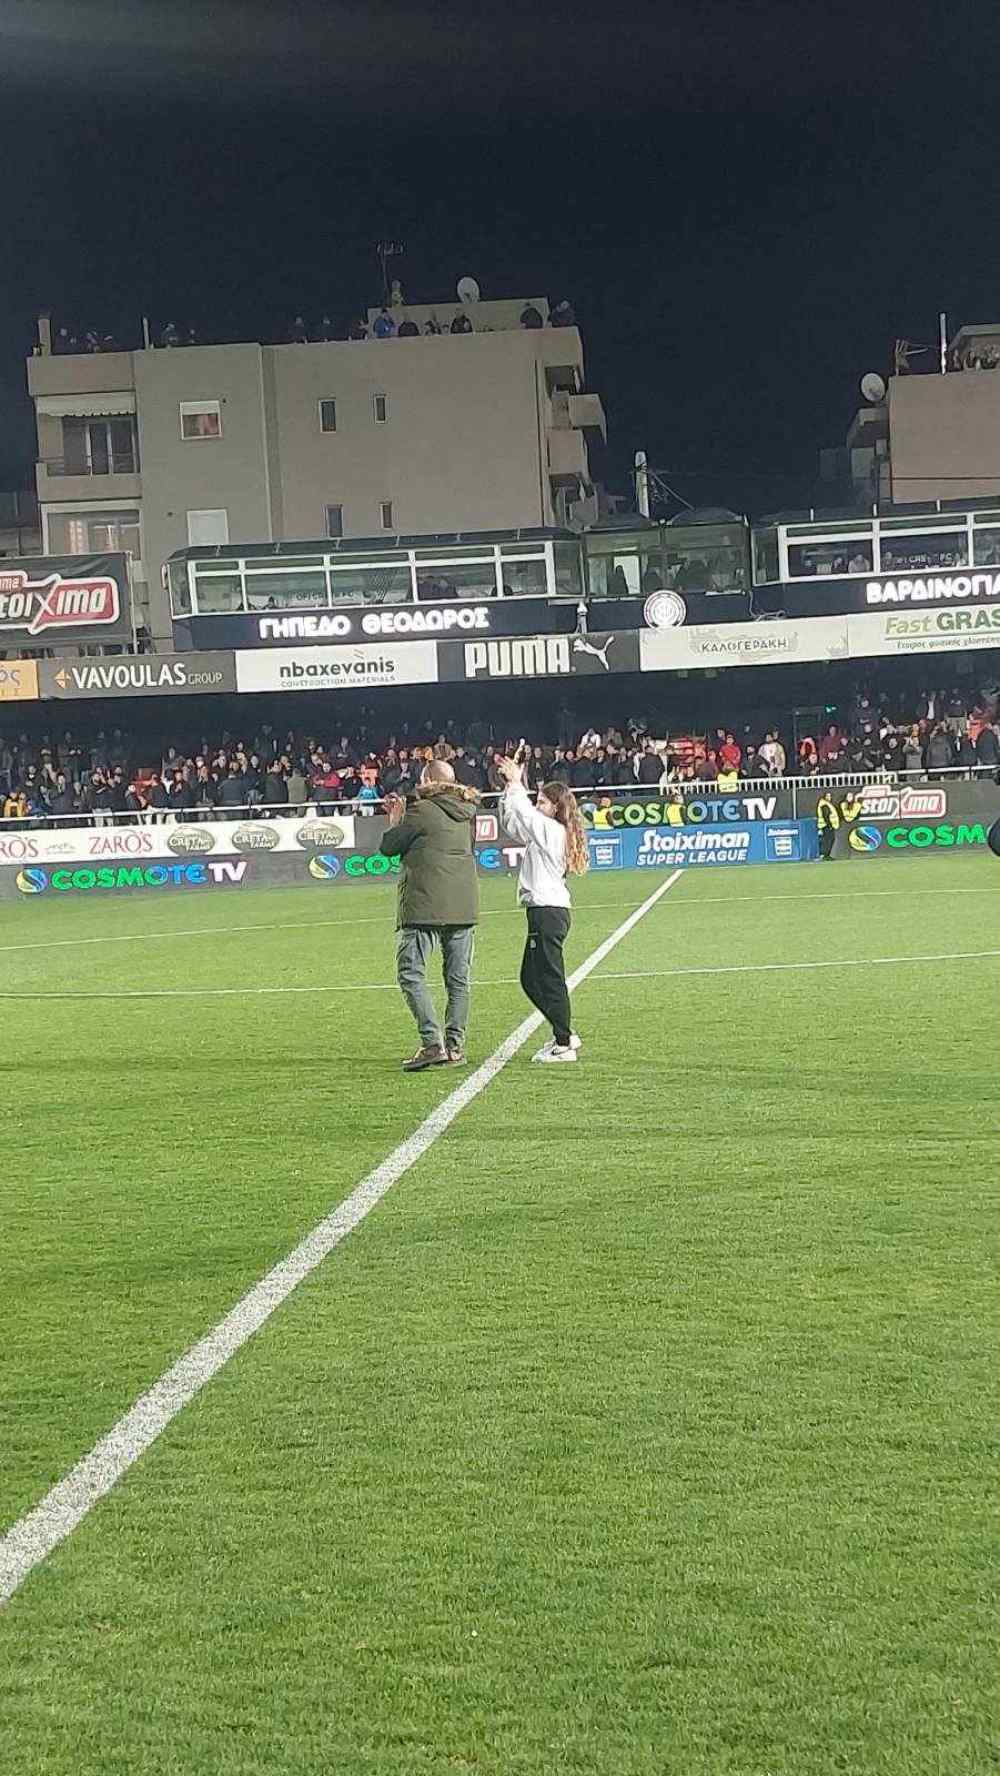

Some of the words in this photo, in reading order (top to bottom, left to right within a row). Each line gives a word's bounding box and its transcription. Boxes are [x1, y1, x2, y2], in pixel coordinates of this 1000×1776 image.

[259, 615, 350, 639] ΓΗΠΕΔΟ
[362, 607, 489, 634] ΘΕΟΔΩΡΟΣ
[886, 616, 932, 634] Fast
[702, 637, 787, 653] ΚΑΛΟΓΕΡΑΚΗ
[280, 656, 394, 678] nbaxevanis
[465, 638, 570, 678] PUMA
[72, 663, 186, 689] VAVOULAS
[188, 671, 223, 685] GROUP
[742, 797, 776, 820] TV
[639, 829, 750, 853] Stoiximan
[636, 851, 685, 866] SUPER
[688, 849, 748, 863] LEAGUE
[51, 862, 207, 891] COSMOTE
[208, 861, 248, 882] TV
